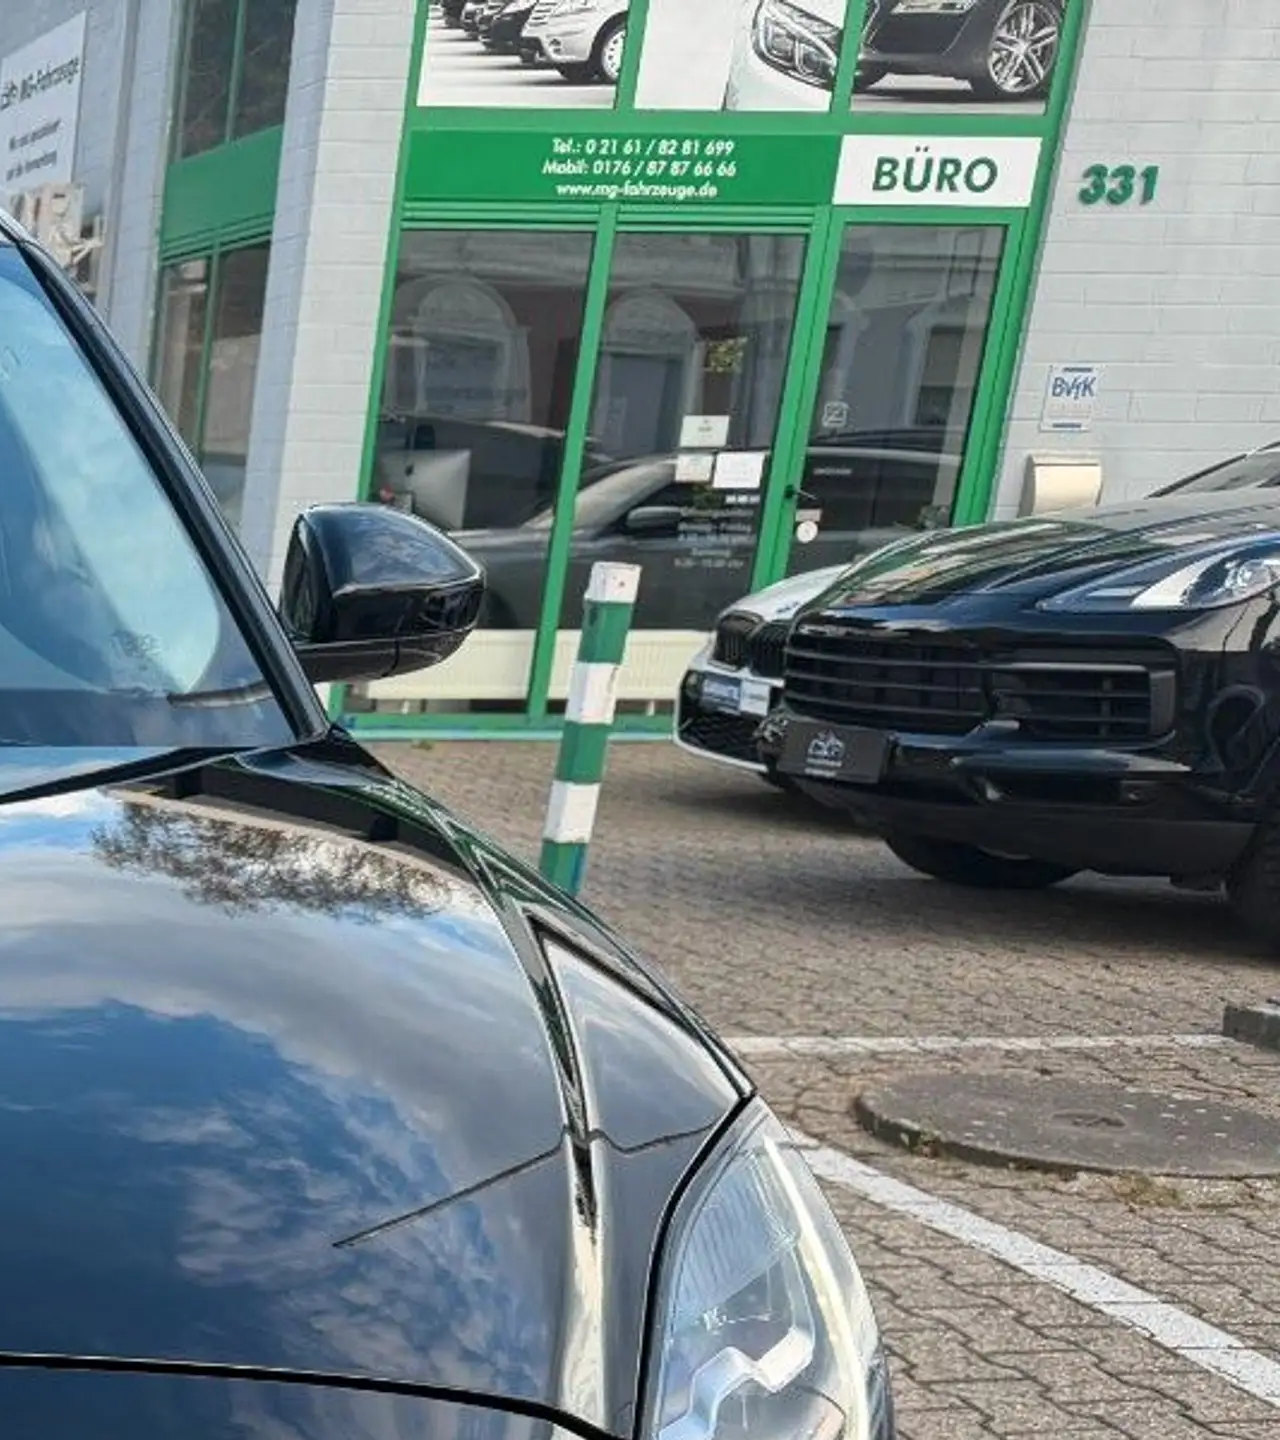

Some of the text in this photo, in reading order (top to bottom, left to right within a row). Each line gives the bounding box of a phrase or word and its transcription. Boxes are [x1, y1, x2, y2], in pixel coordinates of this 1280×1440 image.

[586, 139, 597, 154] 0
[600, 139, 618, 154] 21
[623, 139, 642, 155] 61
[645, 139, 656, 156] /
[658, 139, 679, 155] 82
[681, 140, 699, 155] 81
[705, 140, 736, 156] 699
[592, 160, 632, 175] 0176
[634, 161, 645, 177] /
[646, 161, 668, 176] 87
[670, 161, 692, 176] 87
[694, 161, 714, 177] 66
[716, 161, 738, 177] 66
[872, 145, 998, 193] BÜRO
[555, 180, 718, 200] www.mg-fahrzeuge.de
[1078, 163, 1159, 206] 331
